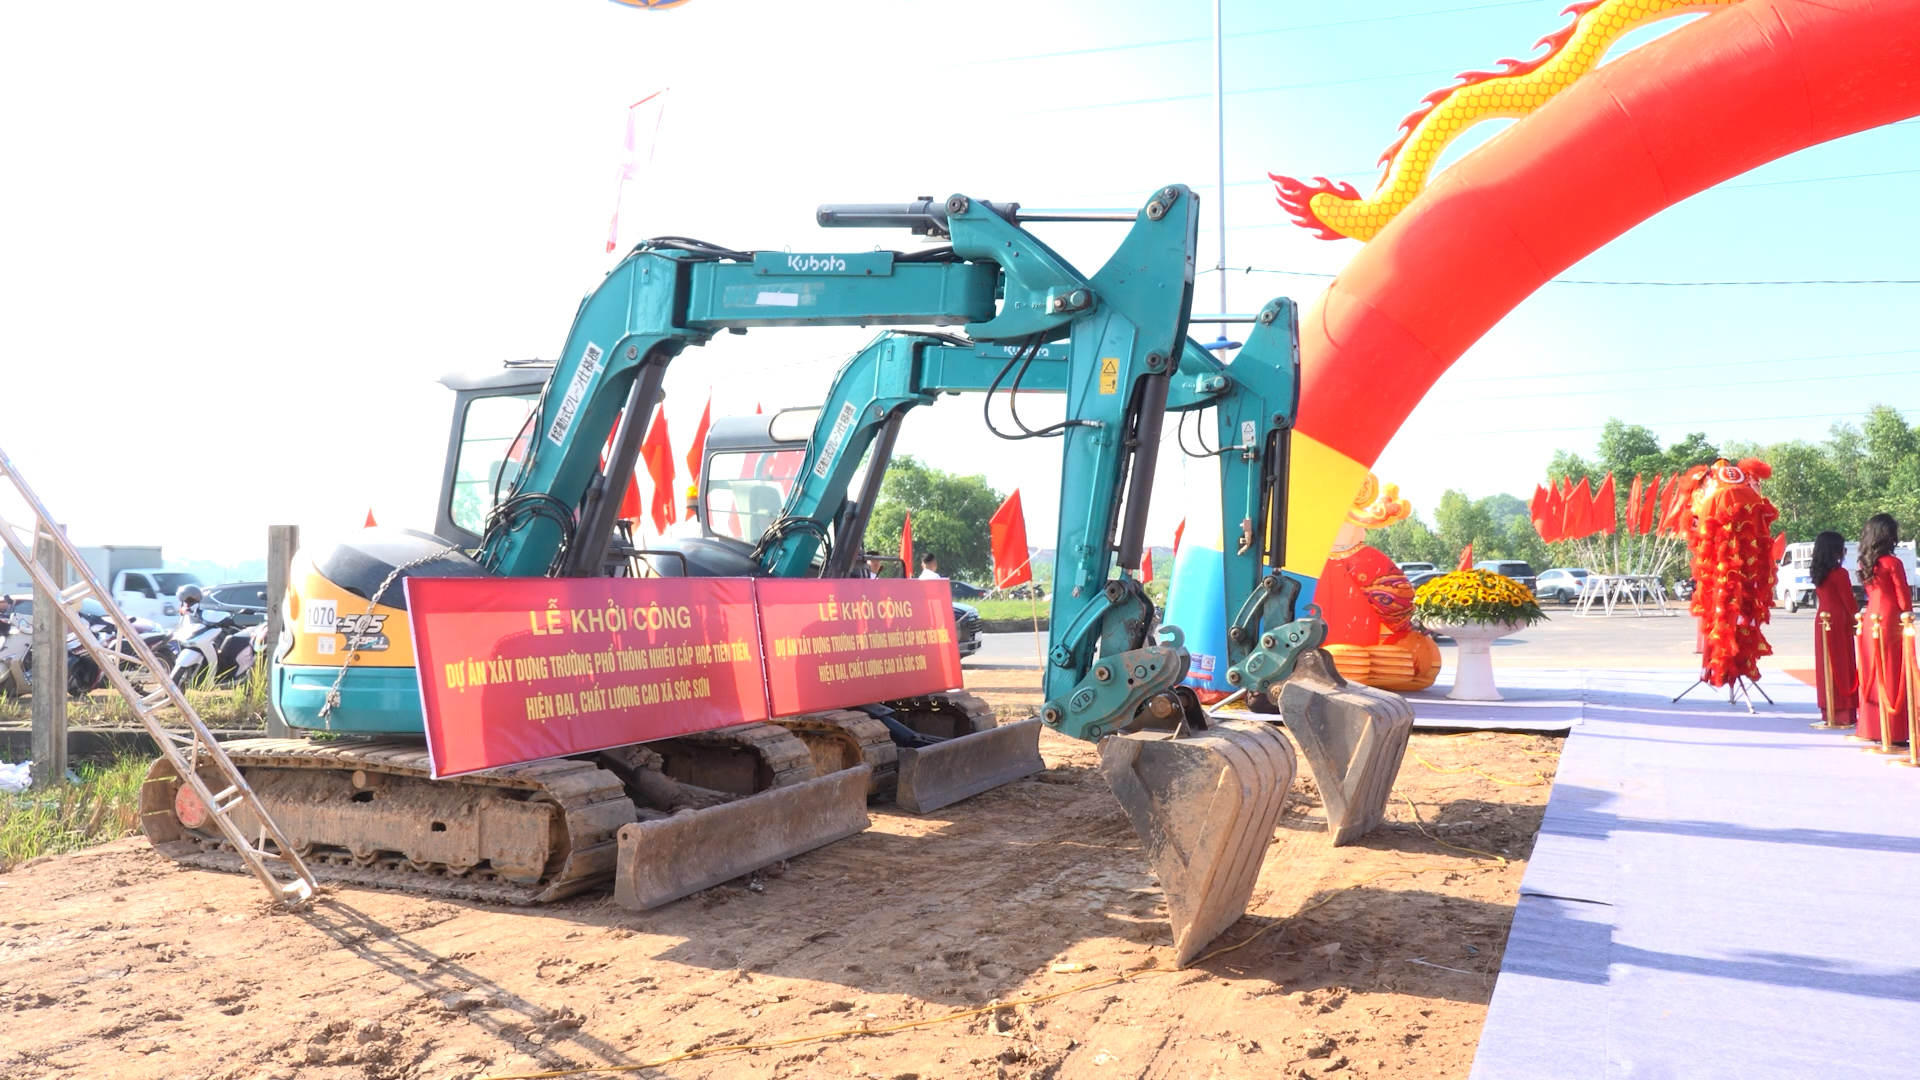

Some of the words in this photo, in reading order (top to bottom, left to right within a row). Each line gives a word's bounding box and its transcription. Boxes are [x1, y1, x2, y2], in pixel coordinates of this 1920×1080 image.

[788, 255, 846, 271] Kubota
[550, 346, 601, 442] 移動式クレーン仕様機
[308, 606, 335, 625] 1070
[530, 598, 564, 635] LỄ
[570, 598, 628, 633] KHỞI
[633, 601, 692, 631] CÔNG
[819, 594, 839, 621] LỄ
[841, 594, 875, 620] KHỞI
[877, 596, 913, 619] CÔNG
[445, 660, 465, 693] DỰ
[468, 657, 487, 686] ÁN
[488, 655, 513, 684] XÂY
[515, 655, 549, 686] DỰNG
[549, 649, 593, 678] TRƯỜNG
[594, 643, 616, 673] PHỔ
[616, 646, 648, 672] THÔNG
[695, 644, 712, 668] HỌC
[712, 640, 731, 663] TIÊN
[731, 637, 752, 663] TIẾN,
[525, 691, 555, 724] HIỆN
[555, 692, 579, 720] ĐẠI,
[579, 682, 606, 713] CHẤT
[608, 684, 640, 712] LƯỢNG
[641, 683, 660, 705] CAO
[660, 678, 674, 703] XÃ
[674, 676, 692, 701] SÓC
[692, 676, 711, 698] SƠN
